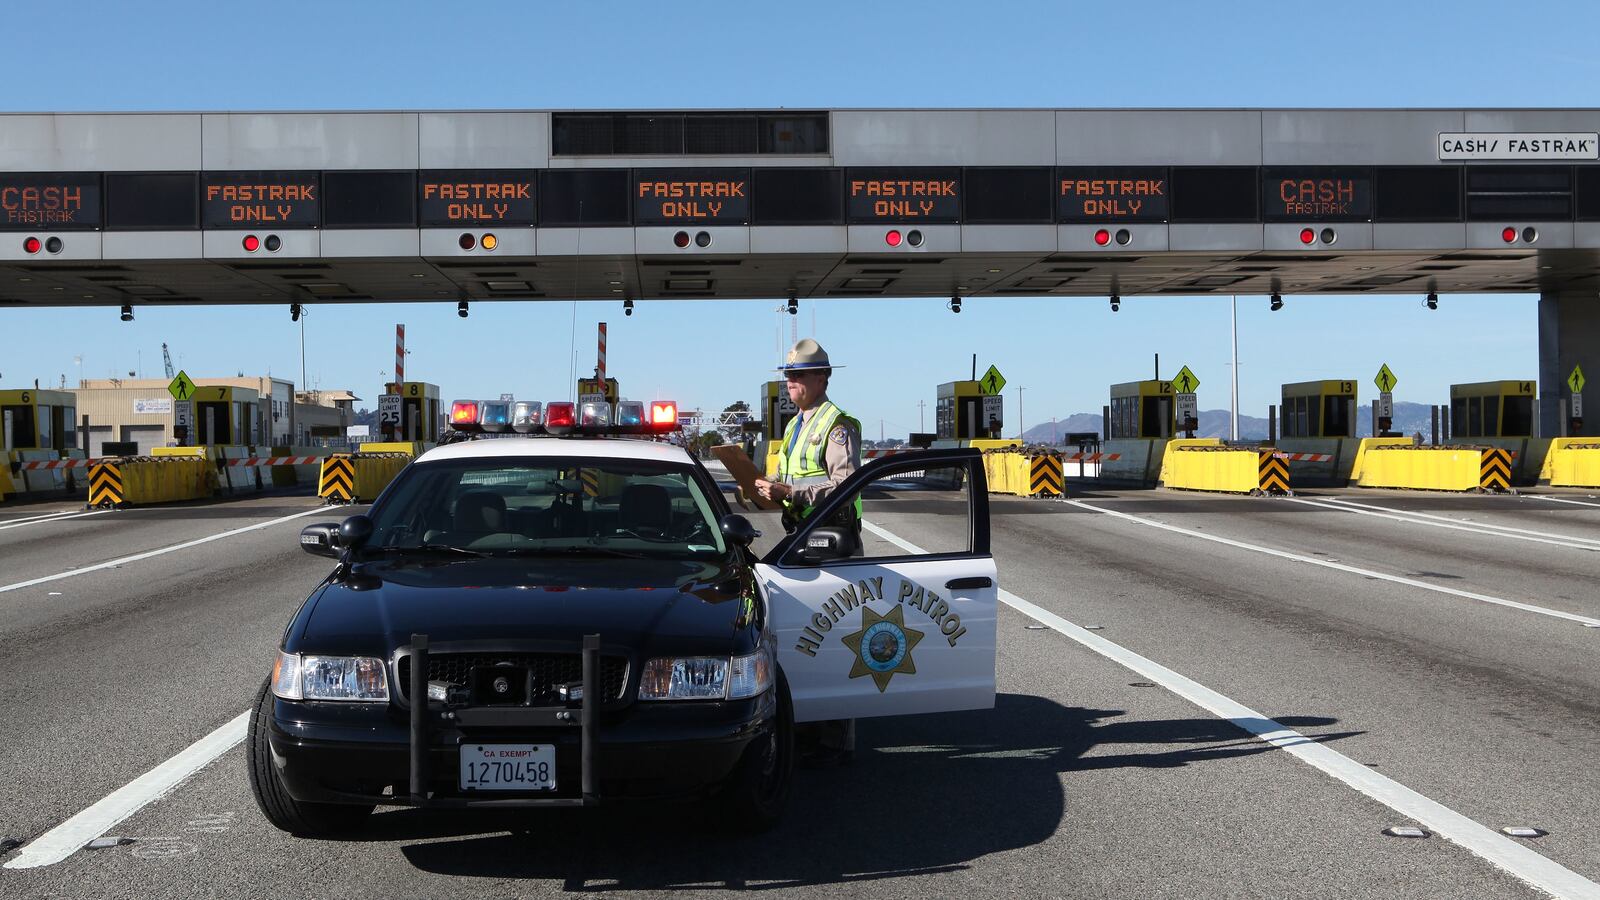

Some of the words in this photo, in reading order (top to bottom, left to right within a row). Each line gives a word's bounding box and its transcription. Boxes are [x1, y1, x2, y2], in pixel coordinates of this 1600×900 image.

[1442, 140, 1498, 153] CASH/
[207, 185, 314, 200] FASTRAK
[424, 184, 529, 199] FASTRAK
[639, 182, 744, 197] FASTRAK
[851, 181, 956, 196] FASTRAK
[1061, 180, 1164, 195] FASTRAK
[1280, 180, 1353, 202] CASH
[2, 187, 81, 208] CASH
[230, 205, 291, 220] ONLY
[447, 204, 508, 219] ONLY
[661, 202, 721, 217] ONLY
[874, 201, 934, 216] ONLY
[1083, 200, 1142, 215] ONLY
[1286, 202, 1350, 214] FASTRAK
[7, 210, 75, 222] FASTRAK
[218, 388, 226, 399] 7
[410, 384, 418, 395] 8
[1160, 382, 1170, 393] 12
[1341, 382, 1352, 393] 13
[1519, 382, 1530, 393] 14
[22, 391, 30, 403] 6
[381, 412, 400, 424] 25
[1383, 406, 1390, 416] 5
[180, 414, 186, 424] 5
[794, 576, 884, 657] HIGHWAY
[898, 580, 967, 647] PATROL
[467, 762, 549, 783] 1270458
